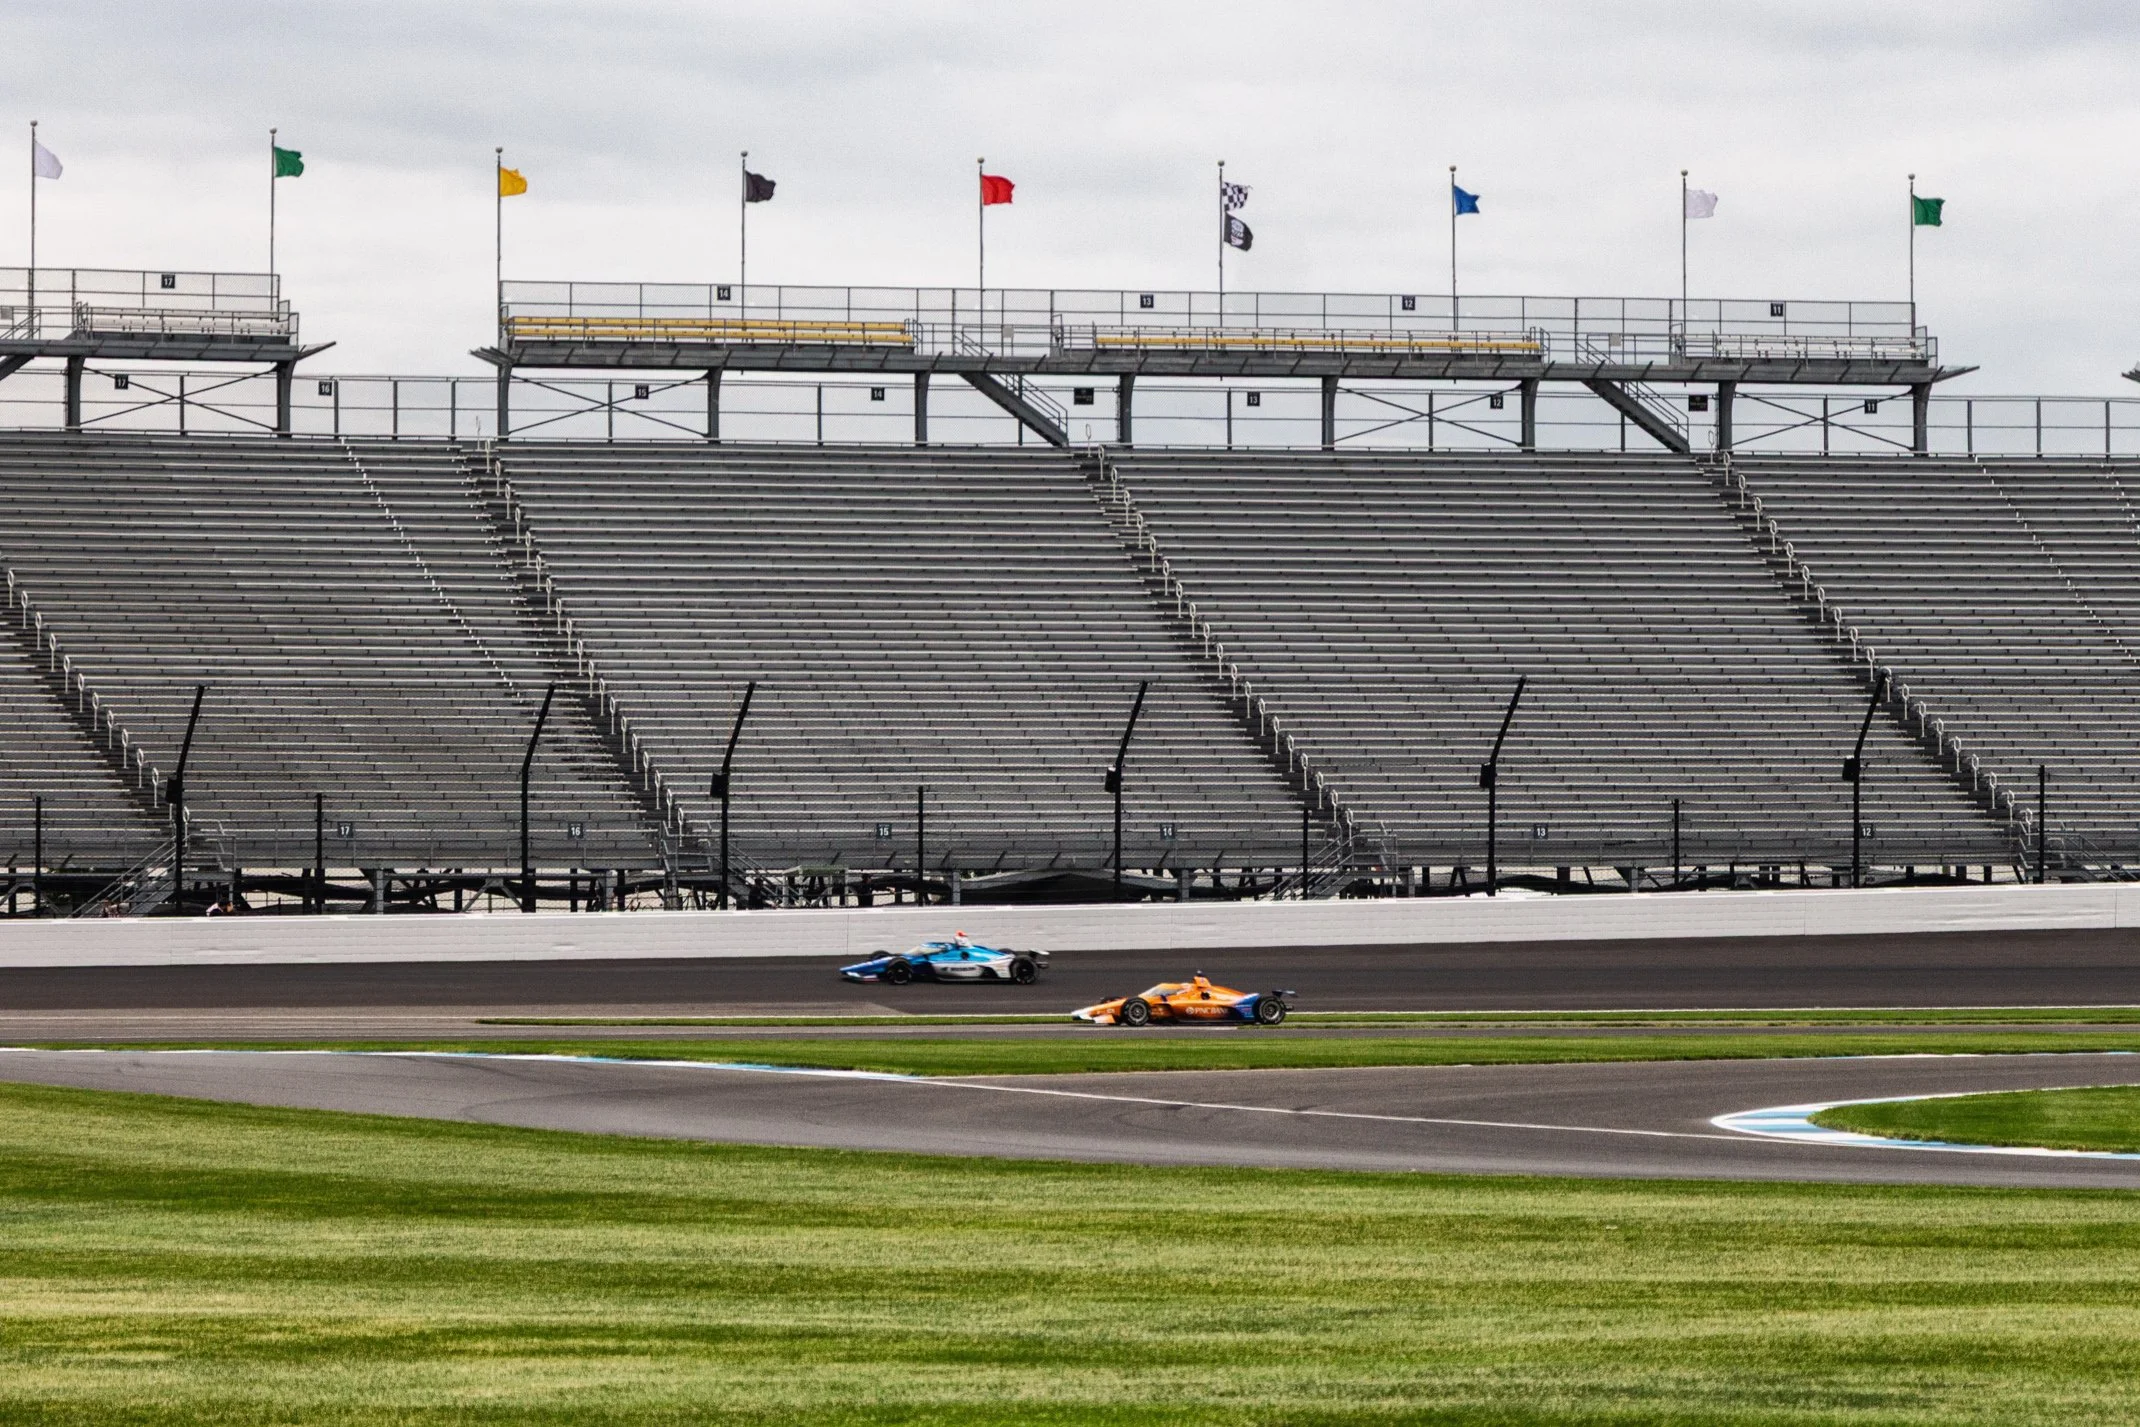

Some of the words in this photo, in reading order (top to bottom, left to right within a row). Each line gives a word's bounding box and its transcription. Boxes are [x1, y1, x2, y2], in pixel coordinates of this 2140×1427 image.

[571, 827, 580, 835] 16
[879, 828, 888, 836] 15
[1537, 828, 1545, 836] 13
[1862, 828, 1871, 836] 12
